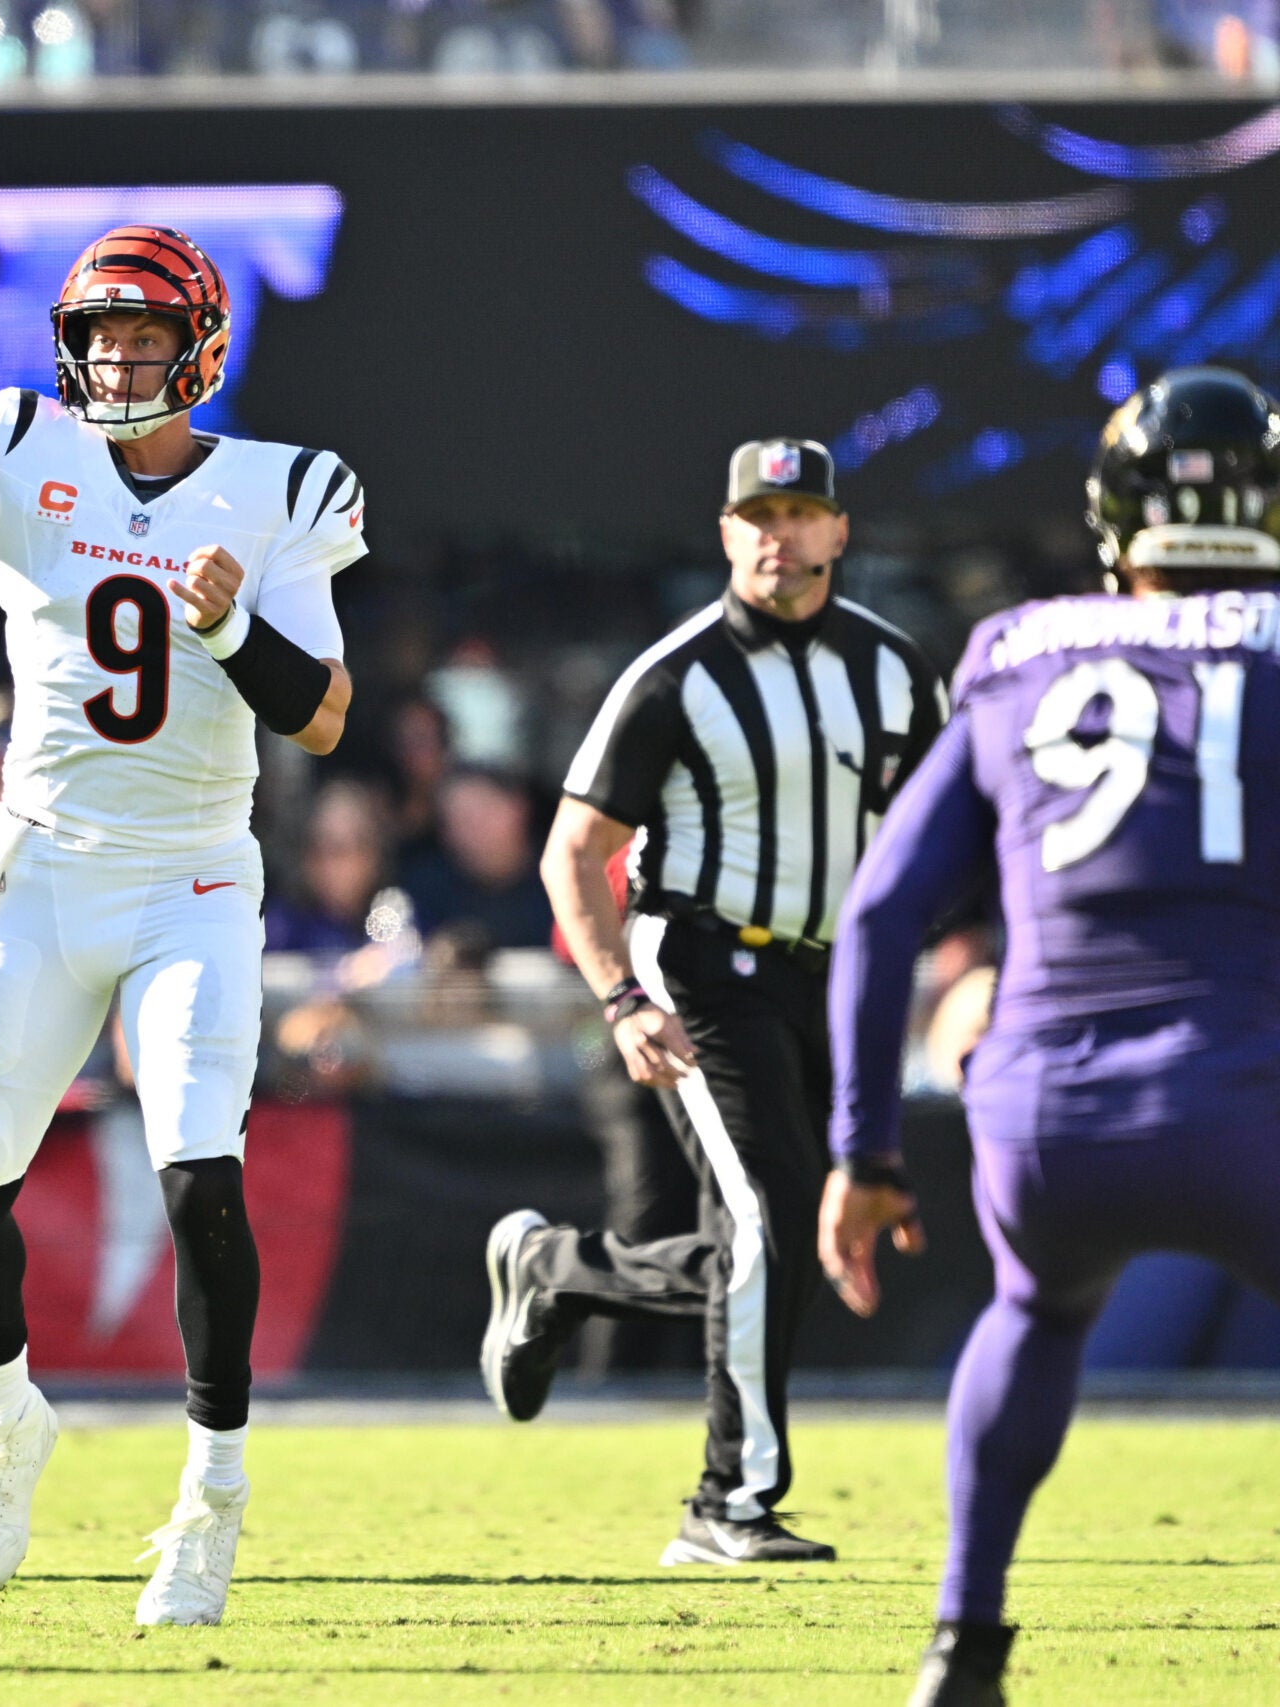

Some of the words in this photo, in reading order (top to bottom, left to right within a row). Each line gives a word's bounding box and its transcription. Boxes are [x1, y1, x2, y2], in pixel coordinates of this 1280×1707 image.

[38, 480, 79, 513] C
[82, 573, 171, 745] 9
[1023, 657, 1245, 873] 91
